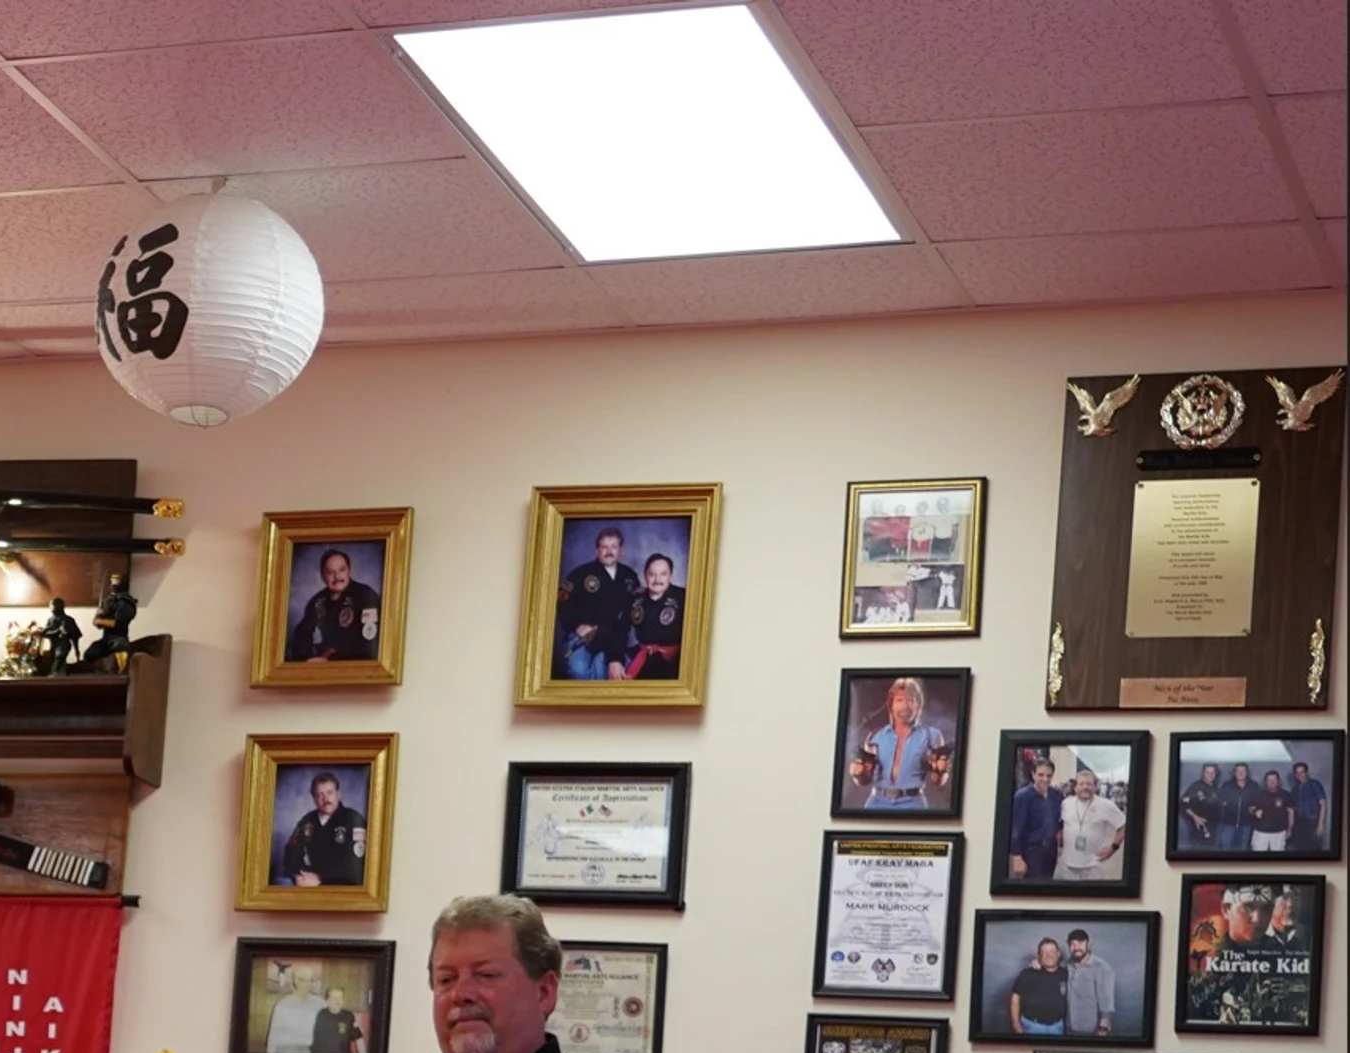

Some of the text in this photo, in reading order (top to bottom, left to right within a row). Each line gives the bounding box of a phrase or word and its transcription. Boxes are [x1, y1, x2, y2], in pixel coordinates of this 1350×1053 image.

[1223, 950, 1245, 960] The
[1206, 957, 1310, 974] Karate Kid
